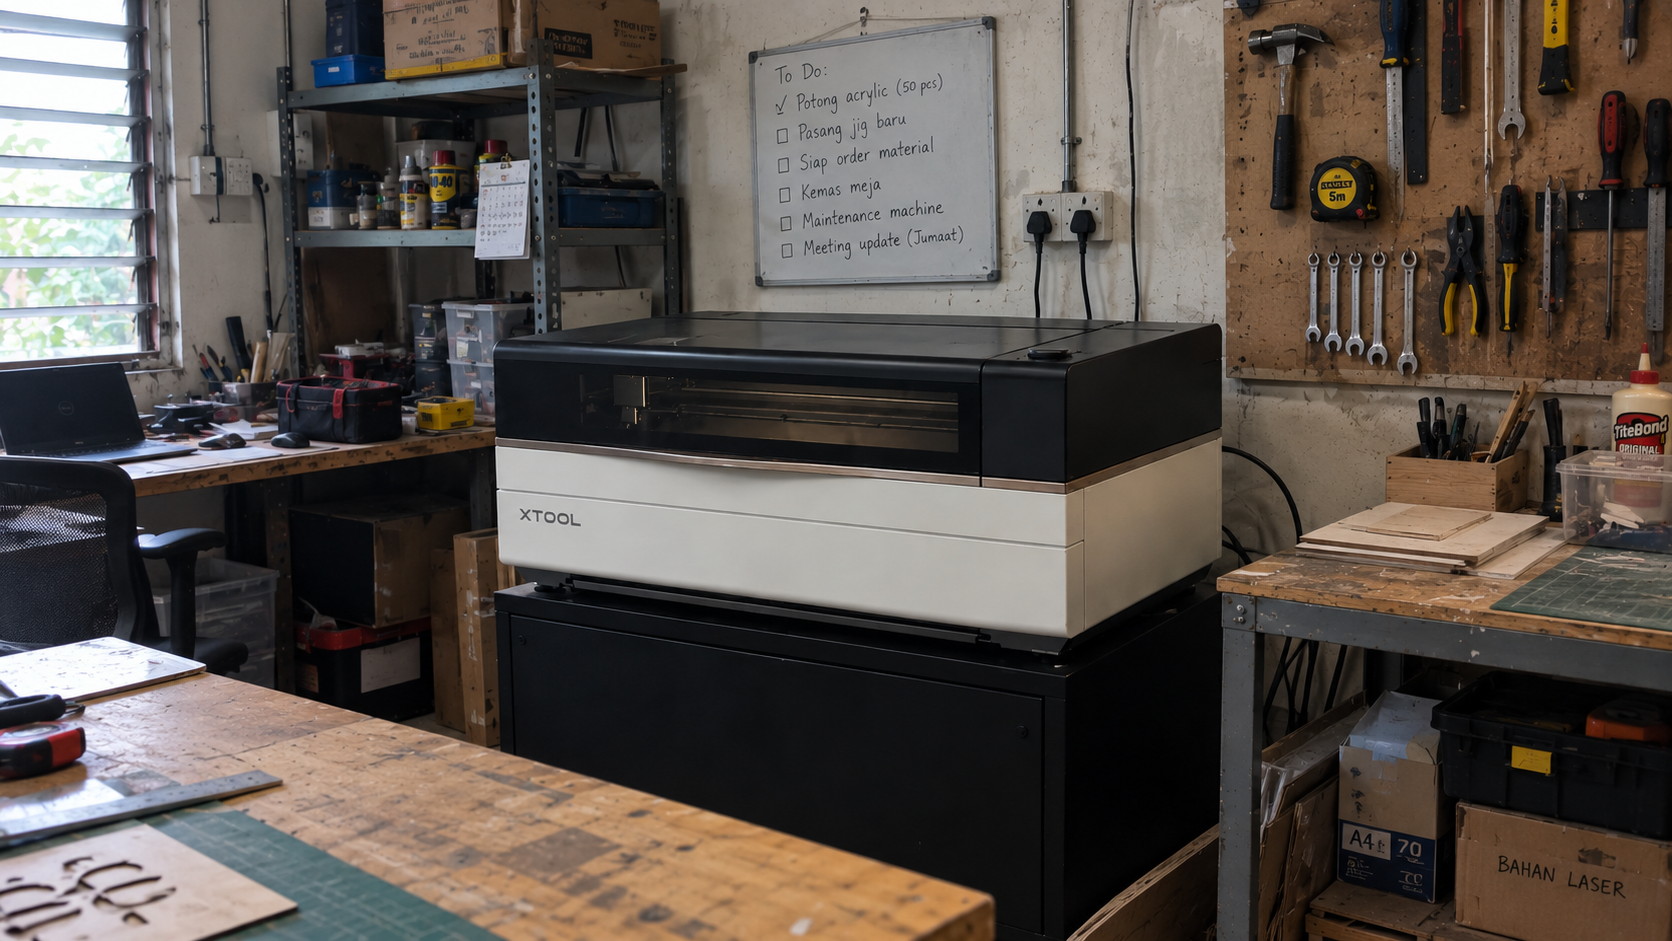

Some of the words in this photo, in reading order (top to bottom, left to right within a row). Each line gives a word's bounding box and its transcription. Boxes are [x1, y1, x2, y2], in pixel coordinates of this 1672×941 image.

[775, 65, 792, 84] To
[802, 63, 828, 80] Do:
[797, 93, 838, 114] Potong
[846, 82, 888, 107] acrylic
[896, 78, 917, 97] (50
[920, 73, 943, 96] pcs)
[798, 123, 842, 143] Pasang
[850, 118, 868, 140] jig
[877, 112, 907, 129] baru
[800, 153, 828, 175] Siap
[837, 150, 870, 165] order
[879, 136, 934, 159] material
[801, 184, 841, 200] Kemas
[850, 178, 881, 199] meja
[1329, 191, 1346, 202] 5m
[803, 209, 881, 229] Maintenance
[890, 200, 944, 218] machine
[804, 241, 851, 260] Meeting
[859, 234, 901, 255] update
[907, 225, 964, 248] (Jumaat)
[1615, 417, 1667, 438] TiteBond
[1619, 443, 1660, 455] ORIGINAL
[519, 508, 582, 527] XTOOL
[1349, 829, 1375, 850] A4
[1398, 838, 1422, 857] 70
[1498, 854, 1556, 883] BAHAN
[1568, 871, 1627, 899] LASER
